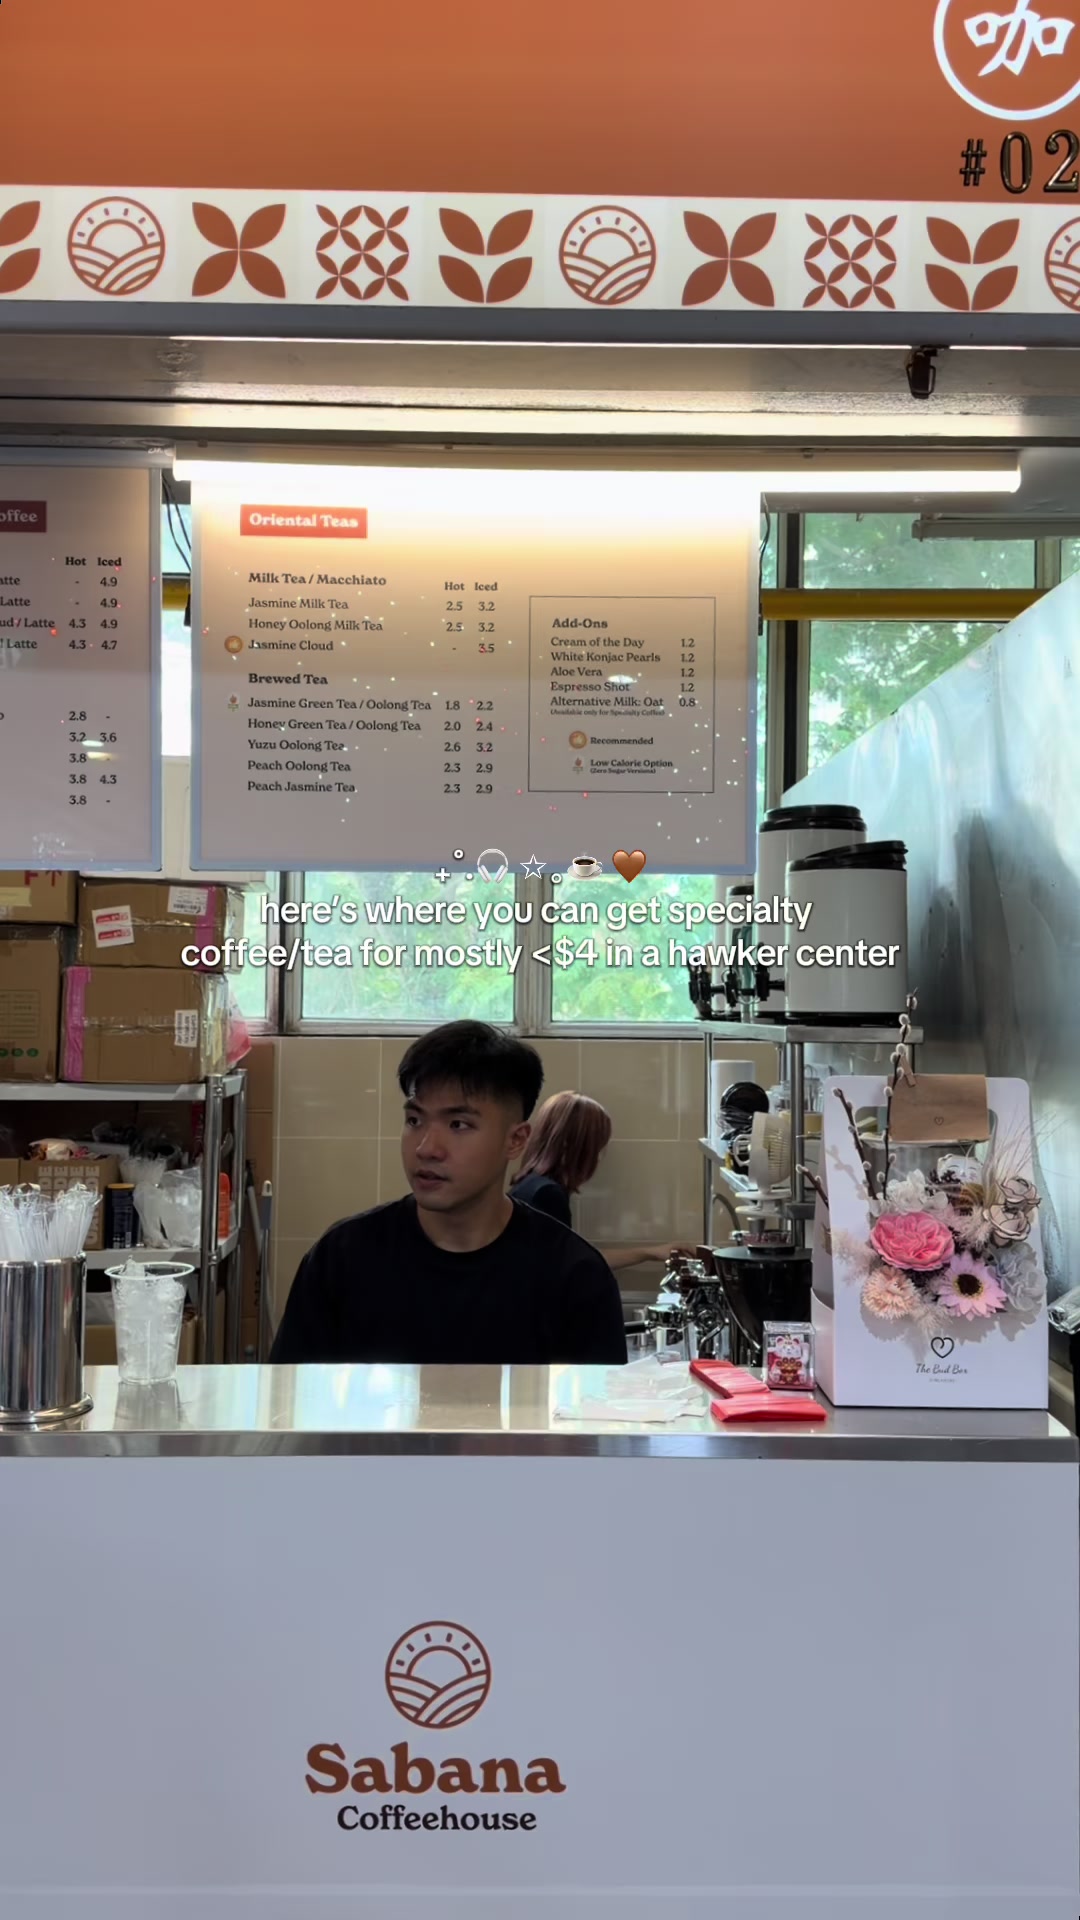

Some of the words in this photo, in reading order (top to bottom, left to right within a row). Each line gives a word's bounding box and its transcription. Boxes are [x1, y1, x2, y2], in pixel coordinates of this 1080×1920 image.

[964, 0, 1075, 76] 咖
[959, 129, 1080, 194] #02
[249, 513, 317, 527] Oriental
[320, 515, 359, 528] Teas
[65, 556, 87, 566] Hot
[97, 557, 122, 567] Iced
[100, 577, 118, 587] 4.9
[248, 572, 279, 584] Milk
[282, 573, 306, 584] Tea
[316, 574, 387, 586] Macchiato
[444, 581, 465, 591] Hot
[474, 581, 498, 592] Iced
[100, 598, 118, 608] 4.9
[248, 597, 297, 608] Jasmine
[299, 598, 325, 609] Milk
[328, 599, 349, 609] Tea
[446, 601, 463, 611] 2.5
[478, 601, 495, 612] 3.2
[24, 618, 55, 628] Latte
[68, 618, 87, 629] 4.3
[100, 619, 118, 629] 4.9
[248, 618, 287, 631] Honey
[289, 619, 332, 632] Oolong
[334, 620, 360, 630] Milk
[362, 620, 383, 631] Tea
[446, 622, 463, 632] 2.5
[478, 622, 495, 633] 3.2
[552, 618, 608, 630] Add-Ons
[6, 638, 38, 649] Latte
[68, 640, 87, 650] 4.3
[101, 640, 118, 650] 4.7
[248, 639, 297, 650] Jasmine
[299, 640, 334, 651] Cloud
[478, 643, 495, 654] 3.5
[550, 637, 590, 648] Cream
[592, 637, 601, 648] of
[603, 637, 620, 648] the
[623, 638, 645, 650] Day
[681, 638, 695, 648] 1.2
[550, 652, 584, 663] White
[586, 652, 623, 665] Konjac
[626, 653, 661, 663] Pearls
[681, 653, 695, 663] 1.2
[550, 667, 575, 677] Aloe
[577, 667, 603, 677] Vera
[681, 667, 695, 678] 1.2
[248, 673, 301, 684] Brewed
[303, 674, 328, 685] Tea
[550, 682, 601, 694] Espresso
[603, 682, 630, 692] Shot
[681, 682, 695, 693] 1.2
[248, 697, 296, 708] Jasmine
[298, 698, 334, 709] Green
[336, 699, 357, 709] Tea
[366, 699, 409, 711] Oolong
[411, 700, 431, 710] Tea
[445, 701, 461, 711] 1.8
[476, 701, 493, 711] 2.2
[550, 696, 611, 707] Alternative
[614, 697, 641, 707] Milk:
[644, 697, 664, 707] Oat
[679, 697, 696, 708] 0.8
[68, 711, 87, 721] 2.8
[248, 718, 286, 731] Honey
[288, 719, 323, 730] Green
[326, 720, 347, 730] Tea
[356, 720, 398, 732] Oolong
[400, 720, 421, 731] Tea
[444, 721, 461, 732] 2.0
[476, 722, 493, 732] 2.4
[68, 732, 87, 742] 3.2
[100, 732, 117, 742] 3.6
[590, 737, 654, 745] Recommended
[248, 739, 276, 750] Yuzu
[279, 740, 322, 752] Oolong
[324, 740, 345, 751] Tea
[444, 742, 461, 753] 2.6
[476, 743, 493, 753] 3.2
[68, 753, 87, 763] 3.8
[590, 759, 609, 768] Low
[611, 759, 642, 768] Calorie
[643, 759, 673, 769] Option
[248, 760, 282, 770] Peach
[285, 760, 328, 773] Oolong
[330, 761, 351, 771] Tea
[444, 763, 461, 774] 2.3
[476, 764, 493, 774] 2.9
[68, 774, 87, 784] 3.8
[100, 774, 117, 785] 4.3
[248, 781, 282, 791] Peach
[284, 781, 332, 792] Jasmine
[335, 782, 355, 792] Tea
[444, 784, 461, 794] 2.3
[476, 784, 493, 795] 2.9
[68, 795, 87, 805] 3.8
[305, 1741, 567, 1794] Sabana
[337, 1804, 537, 1831] Coffeehouse
